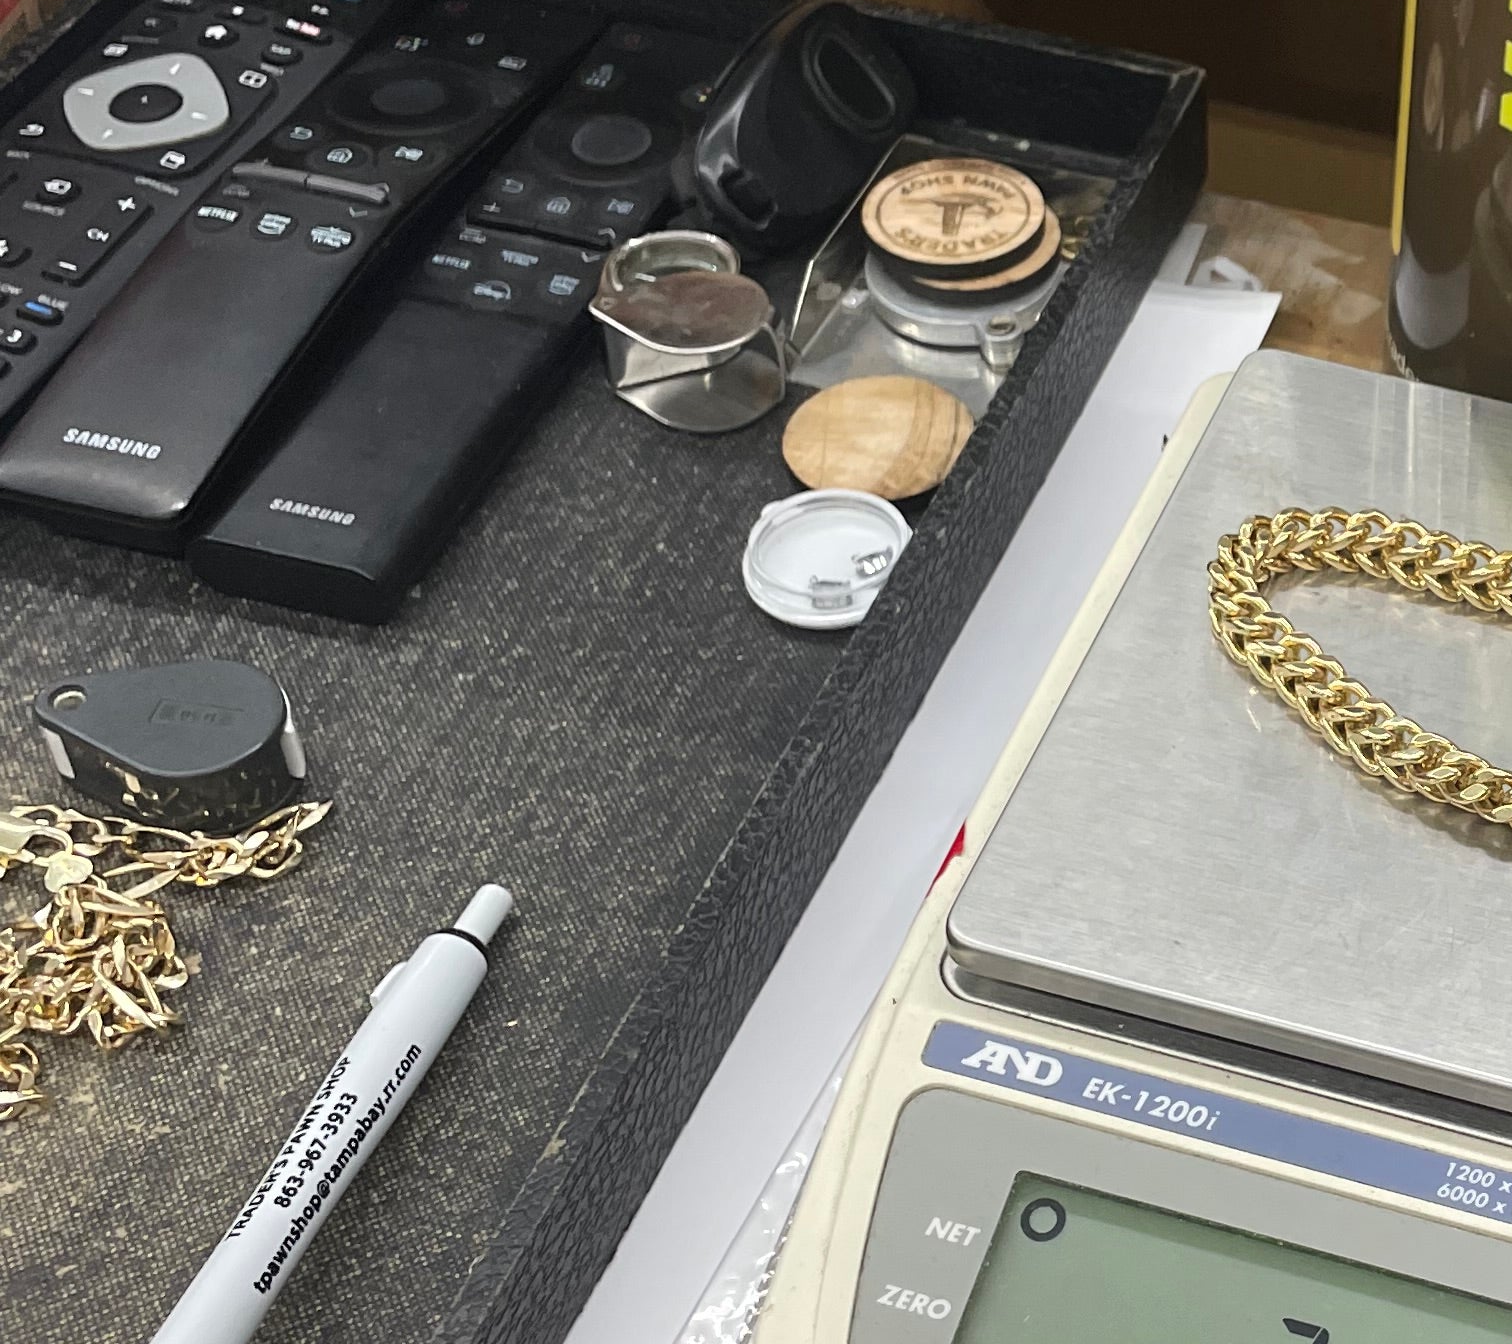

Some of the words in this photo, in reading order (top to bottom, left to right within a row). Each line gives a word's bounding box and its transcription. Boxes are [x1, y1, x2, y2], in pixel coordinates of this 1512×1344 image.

[63, 427, 162, 460] SAMSUNG
[269, 497, 356, 526] SAMSUNG
[961, 1040, 1063, 1086] AND
[1082, 1077, 1221, 1131] EK-1200i
[284, 1103, 324, 1155] PAWN
[316, 1056, 351, 1101] SHOP
[274, 1092, 358, 1208] 863-967-3933
[253, 1044, 422, 1294] tpawnshop@tampabay.rr.com
[1446, 1162, 1495, 1188] 1200
[1499, 1180, 1512, 1193] x
[1436, 1183, 1489, 1209] 6000
[1492, 1201, 1505, 1214] x
[925, 1217, 982, 1246] NET
[876, 1284, 952, 1320] ZERO
